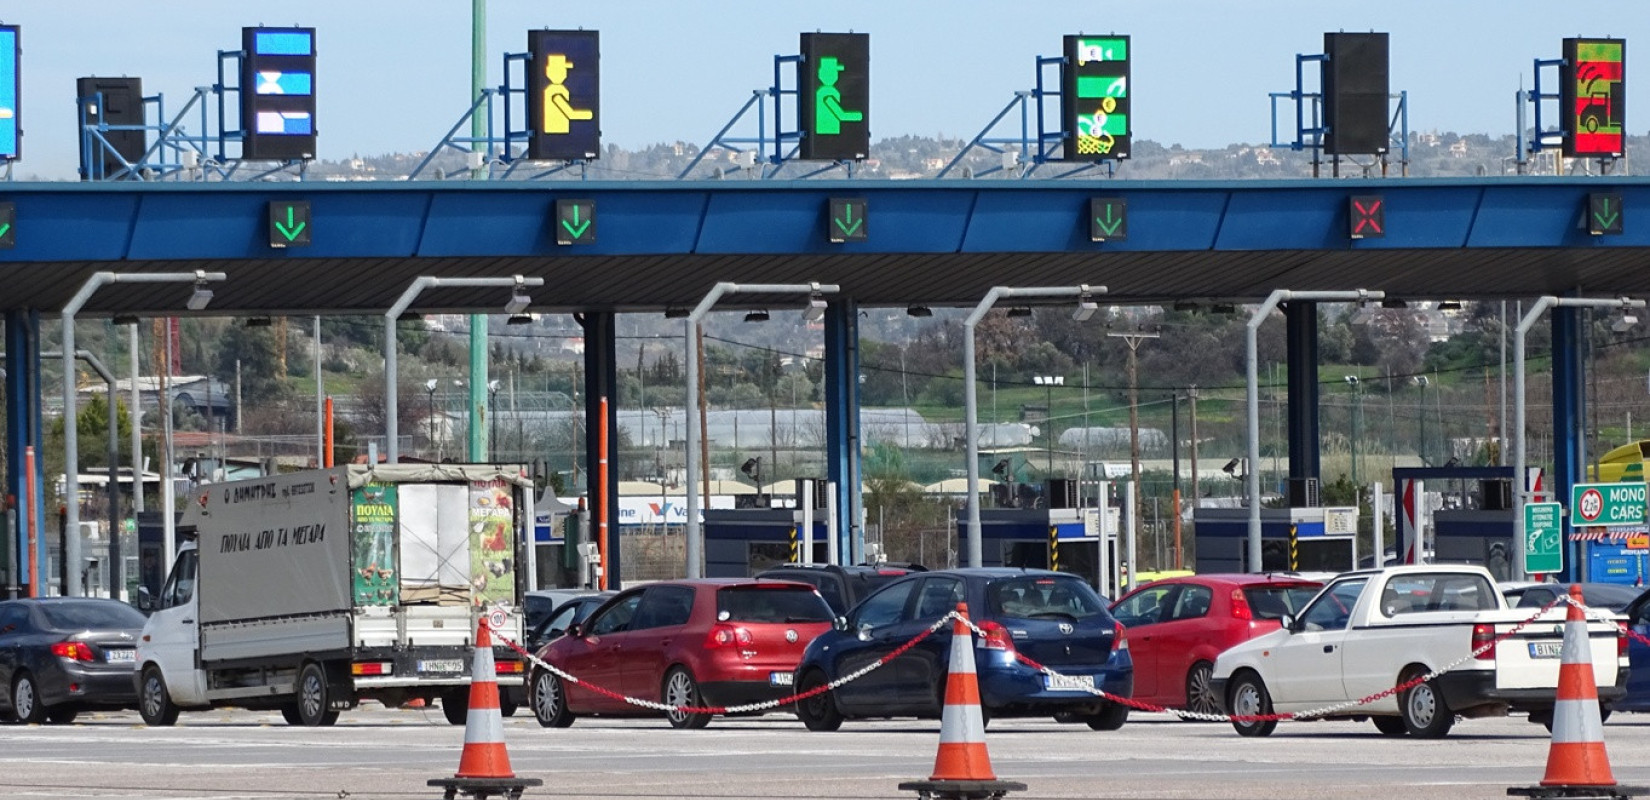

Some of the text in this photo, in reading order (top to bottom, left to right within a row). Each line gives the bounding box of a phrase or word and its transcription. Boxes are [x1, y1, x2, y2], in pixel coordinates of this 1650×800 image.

[1610, 488, 1646, 502] MONO
[356, 504, 394, 516] ΠΟΥΛΙΑ
[1610, 505, 1643, 520] CARS
[220, 523, 326, 554] ΠΟΥΛΙΑ ΑΠΟ ΤΑ ΜΕΓΑΡΑ
